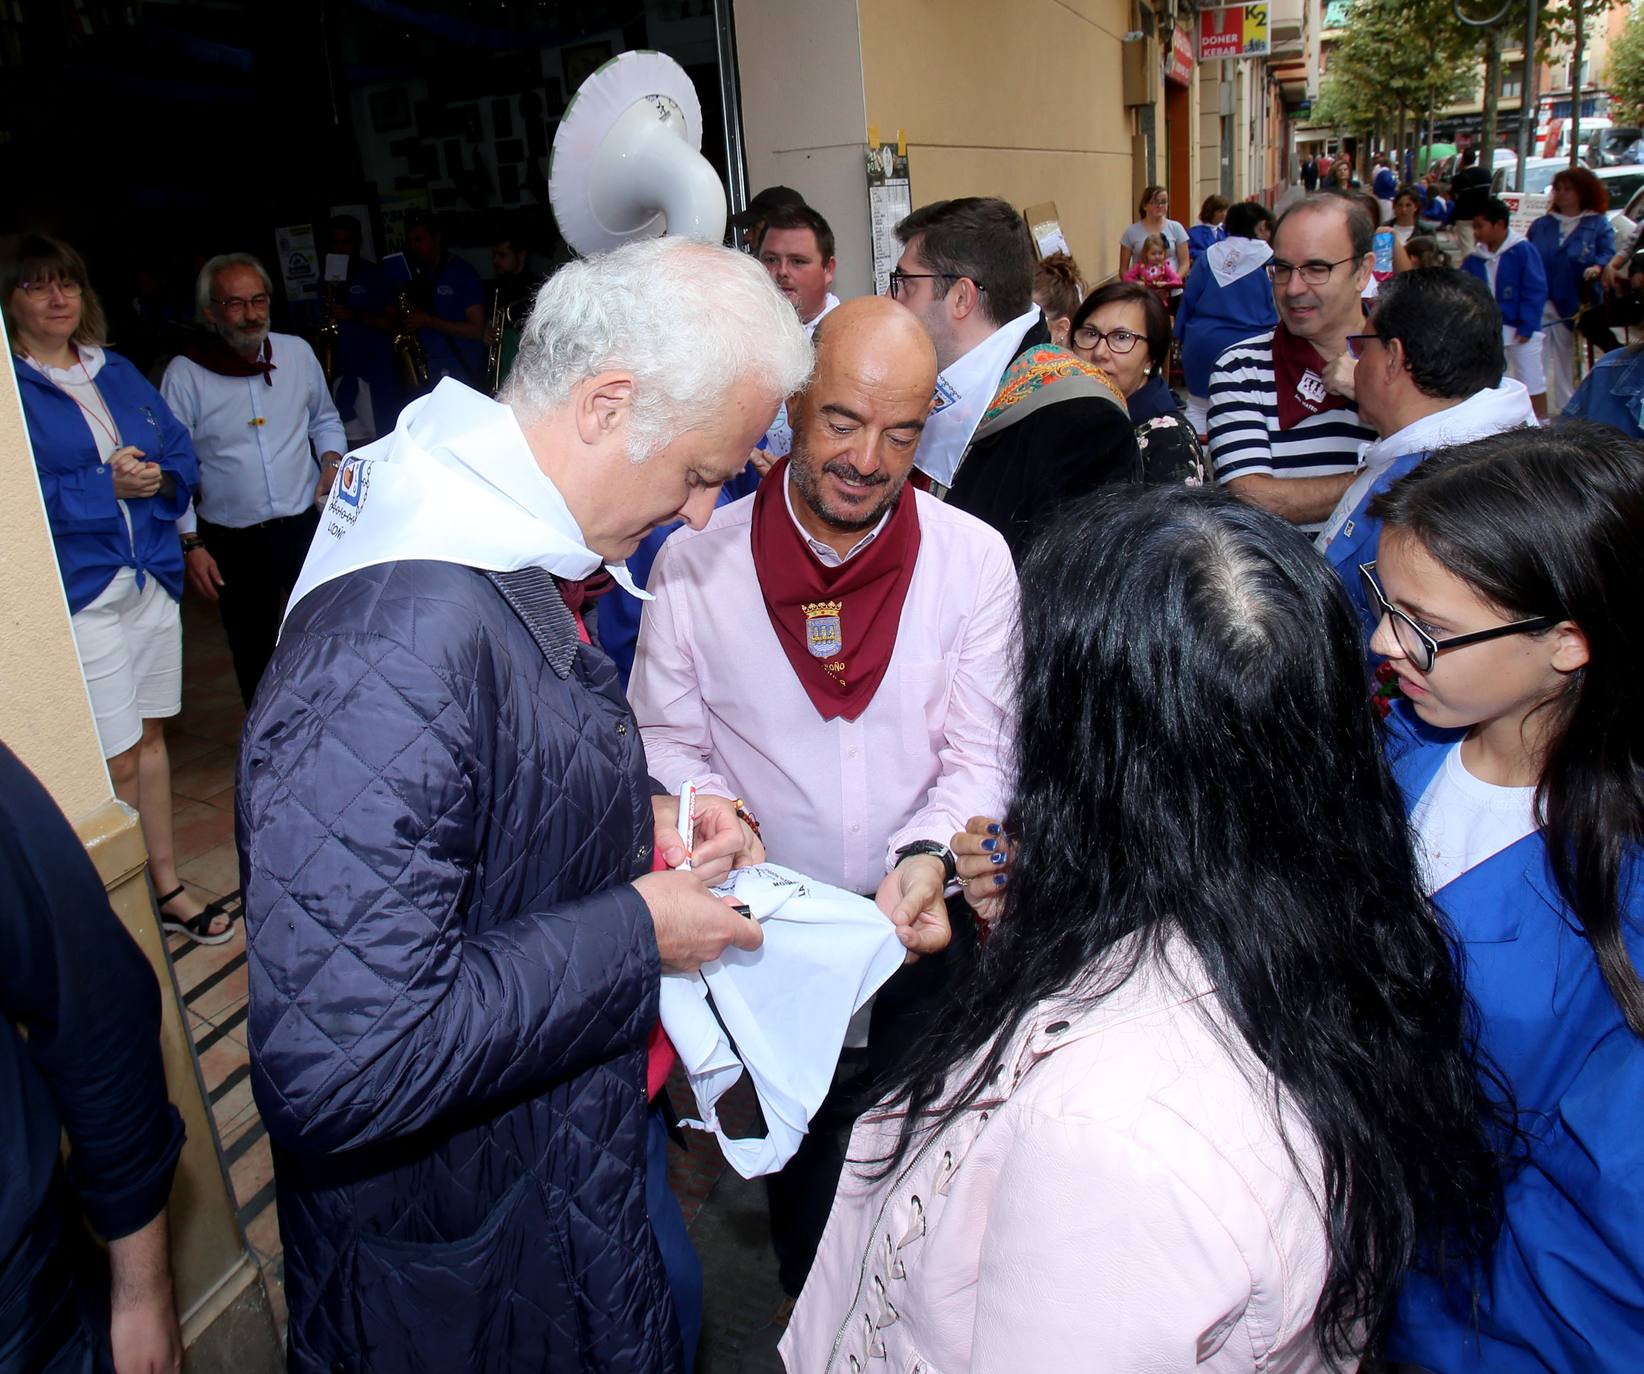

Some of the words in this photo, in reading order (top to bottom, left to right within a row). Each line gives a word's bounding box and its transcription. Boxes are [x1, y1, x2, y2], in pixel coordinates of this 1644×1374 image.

[1245, 5, 1267, 26] K2
[1202, 33, 1239, 45] DONER
[1203, 46, 1237, 57] KEBAB
